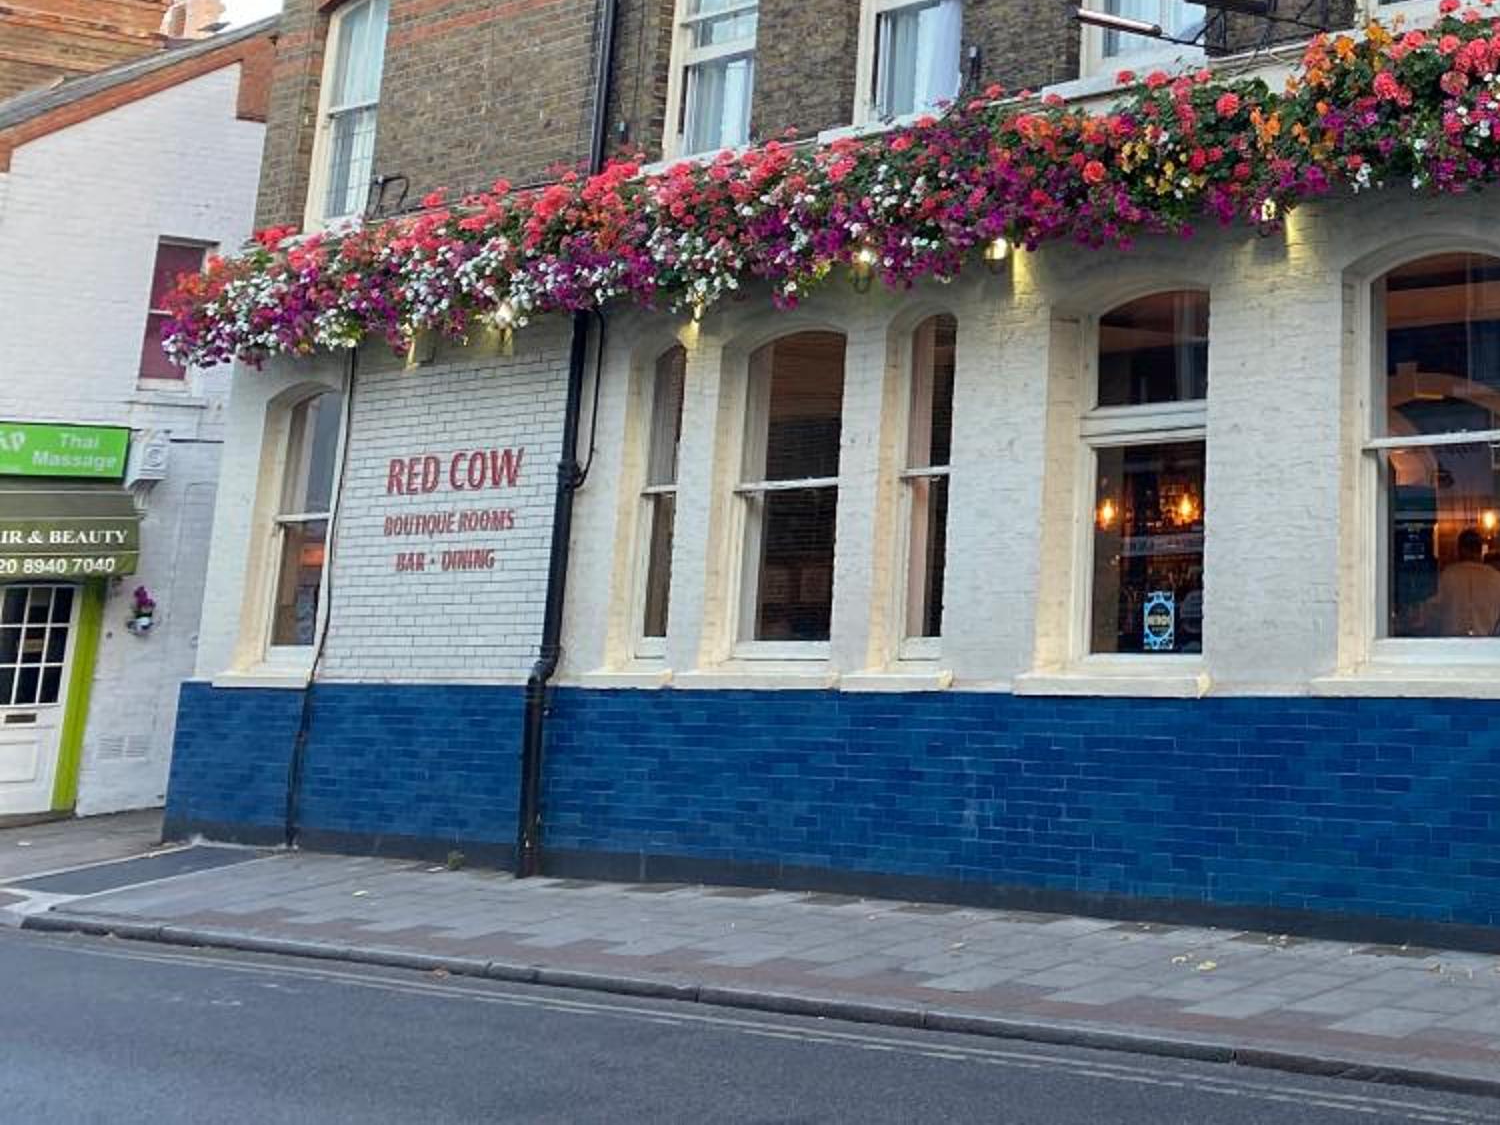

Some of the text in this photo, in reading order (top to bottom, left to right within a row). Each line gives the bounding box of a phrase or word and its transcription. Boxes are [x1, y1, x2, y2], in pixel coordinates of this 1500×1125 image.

[59, 432, 99, 449] Thai
[31, 450, 117, 471] Massage
[387, 447, 525, 495] RED COW
[383, 508, 515, 539] BOUTIQUE ROOMS
[27, 530, 44, 544] &
[50, 529, 128, 544] BEAUTY
[23, 558, 67, 574] 8940
[72, 557, 116, 573] 7040
[395, 548, 496, 572] BAR DINING
